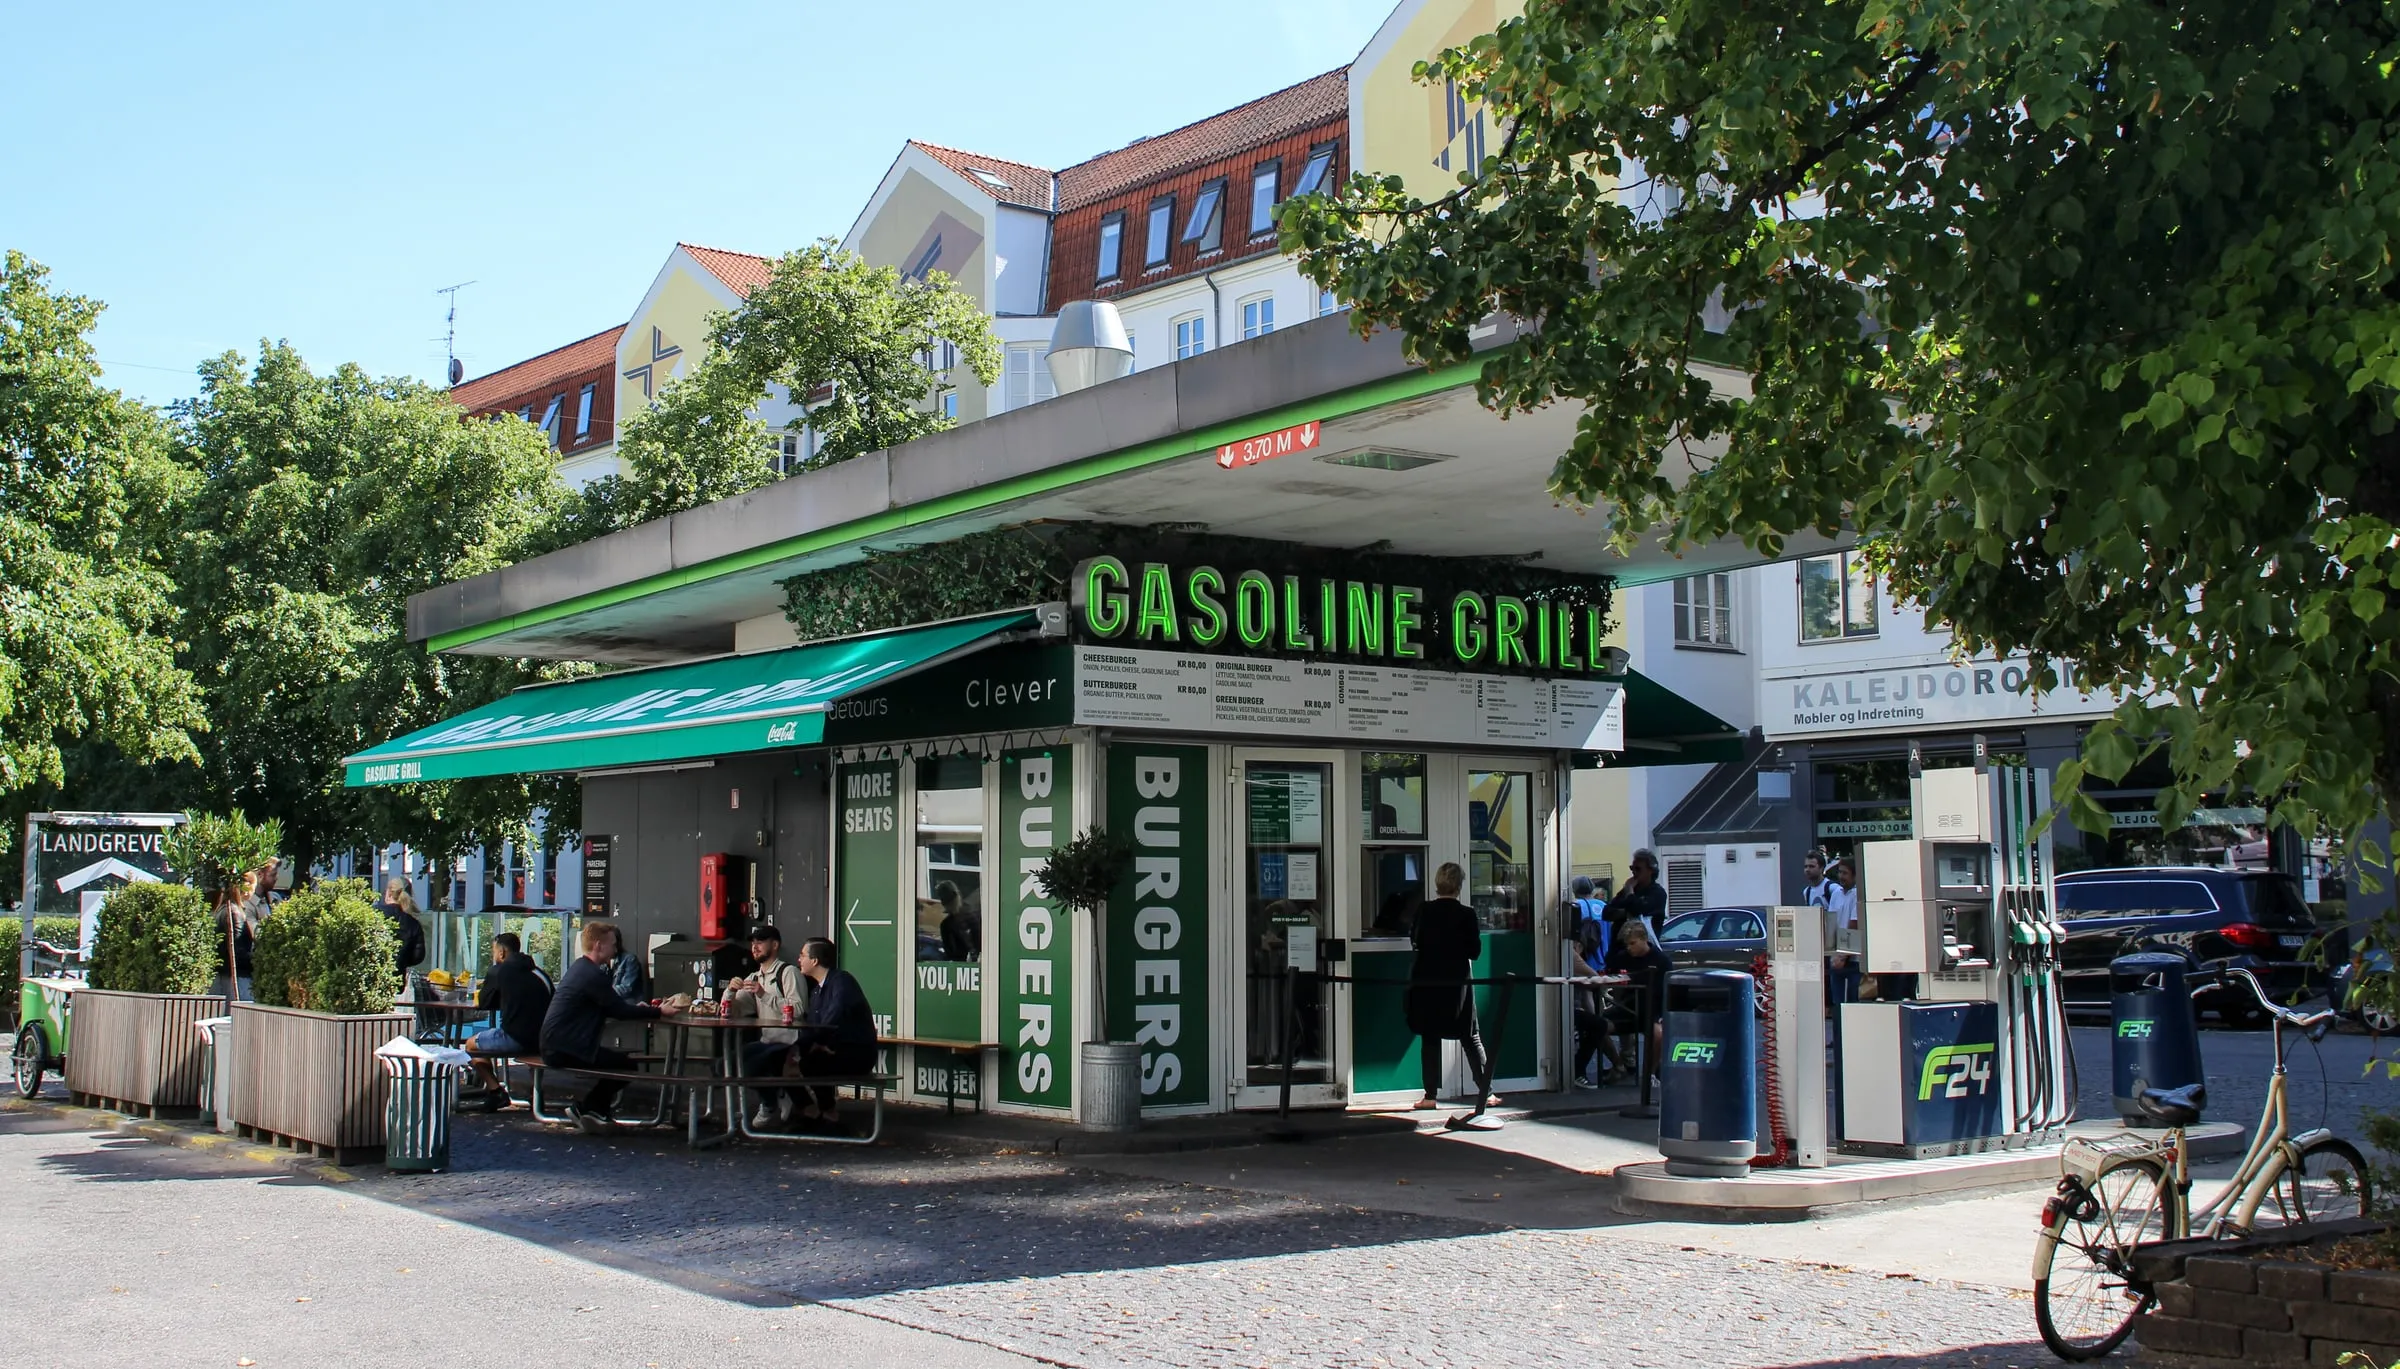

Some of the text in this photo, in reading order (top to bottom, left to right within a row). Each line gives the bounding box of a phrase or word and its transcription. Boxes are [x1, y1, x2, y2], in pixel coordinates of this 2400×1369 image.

[1243, 431, 1291, 461] 3.70 M
[1072, 555, 1613, 672] GASOLINE GRILL
[1083, 653, 1206, 670] CHEESEBURGER KR 80,00
[1216, 662, 1331, 677] ORIGINAL BURGER KR 80,00
[966, 677, 1057, 708] Clever
[1083, 680, 1206, 695] BUTTERBURGER KR 80,00
[1793, 662, 2074, 709] KALEJDORO
[1216, 695, 1332, 710] GREEN BURGER KR 80,00
[1794, 706, 1924, 725] Møbler og Indretning
[1910, 749, 1920, 762] A
[1976, 743, 1985, 756] B
[366, 762, 422, 783] GASOLINE GRILL
[847, 772, 892, 799] MORE
[845, 806, 893, 834] SEATS
[1827, 824, 1909, 834] KALEJDOROOM
[42, 833, 163, 853] LANDGREVE
[1018, 756, 1053, 1094] BURGERS
[1134, 756, 1182, 1095] BURGERS
[917, 966, 980, 996] YOU, ME
[872, 1014, 892, 1038] HE
[2118, 1020, 2154, 1038] F24
[1672, 1042, 1718, 1064] F24
[1918, 1042, 1995, 1100] F24
